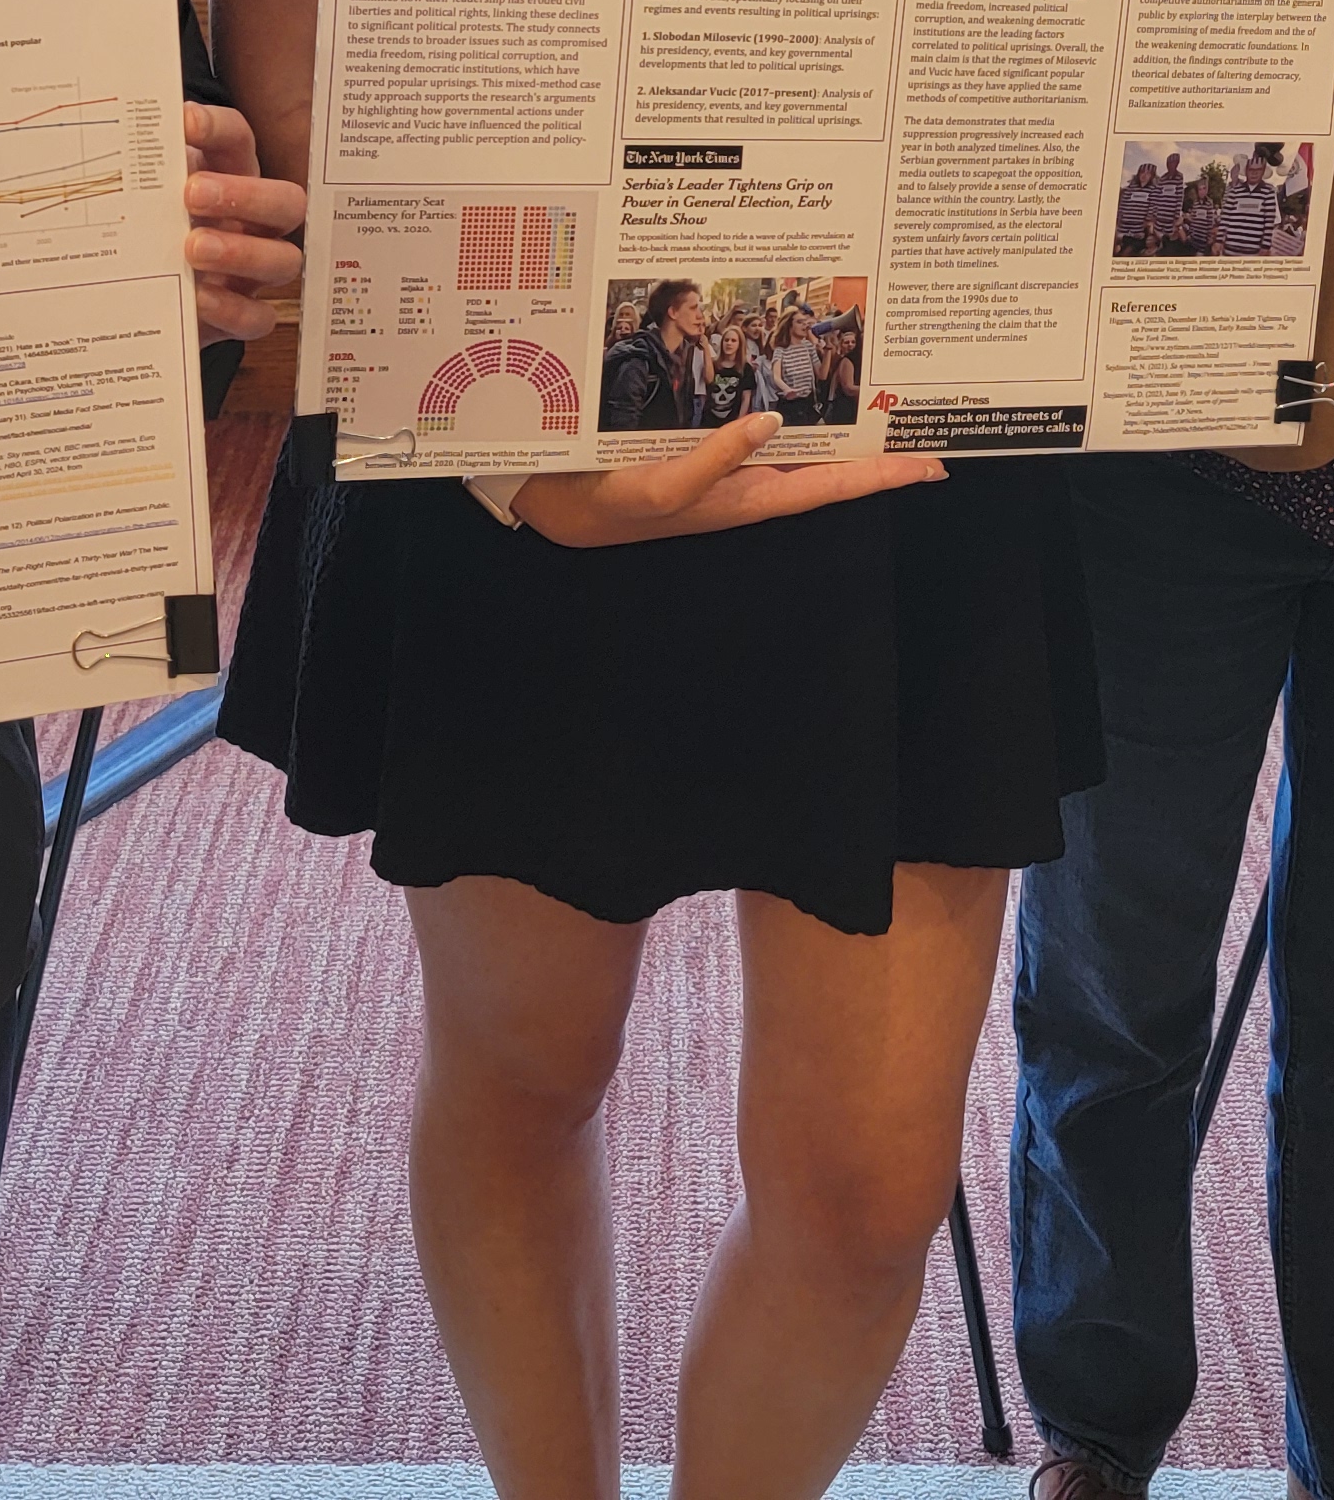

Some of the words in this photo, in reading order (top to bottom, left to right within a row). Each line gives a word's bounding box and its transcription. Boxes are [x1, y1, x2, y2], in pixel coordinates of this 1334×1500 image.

[625, 150, 649, 164] The
[649, 150, 675, 164] New
[675, 152, 705, 168] York
[705, 150, 741, 164] Times
[676, 177, 724, 190] Leader
[728, 178, 782, 192] Tightens
[786, 178, 814, 192] Grip
[817, 182, 833, 190] on
[621, 195, 664, 207] Power
[666, 195, 679, 207] in
[683, 195, 736, 207] General
[737, 195, 793, 208] Election,
[797, 195, 832, 209] Early
[620, 212, 667, 225] Results
[669, 212, 707, 224] Show
[1111, 301, 1176, 312] References
[867, 390, 899, 414] AP
[901, 396, 959, 408] Associated
[961, 395, 989, 404] Press
[887, 414, 945, 426] Protesters
[947, 412, 973, 422] back
[991, 411, 1009, 421] the
[1011, 411, 1049, 420] streets
[1051, 409, 1063, 419] of
